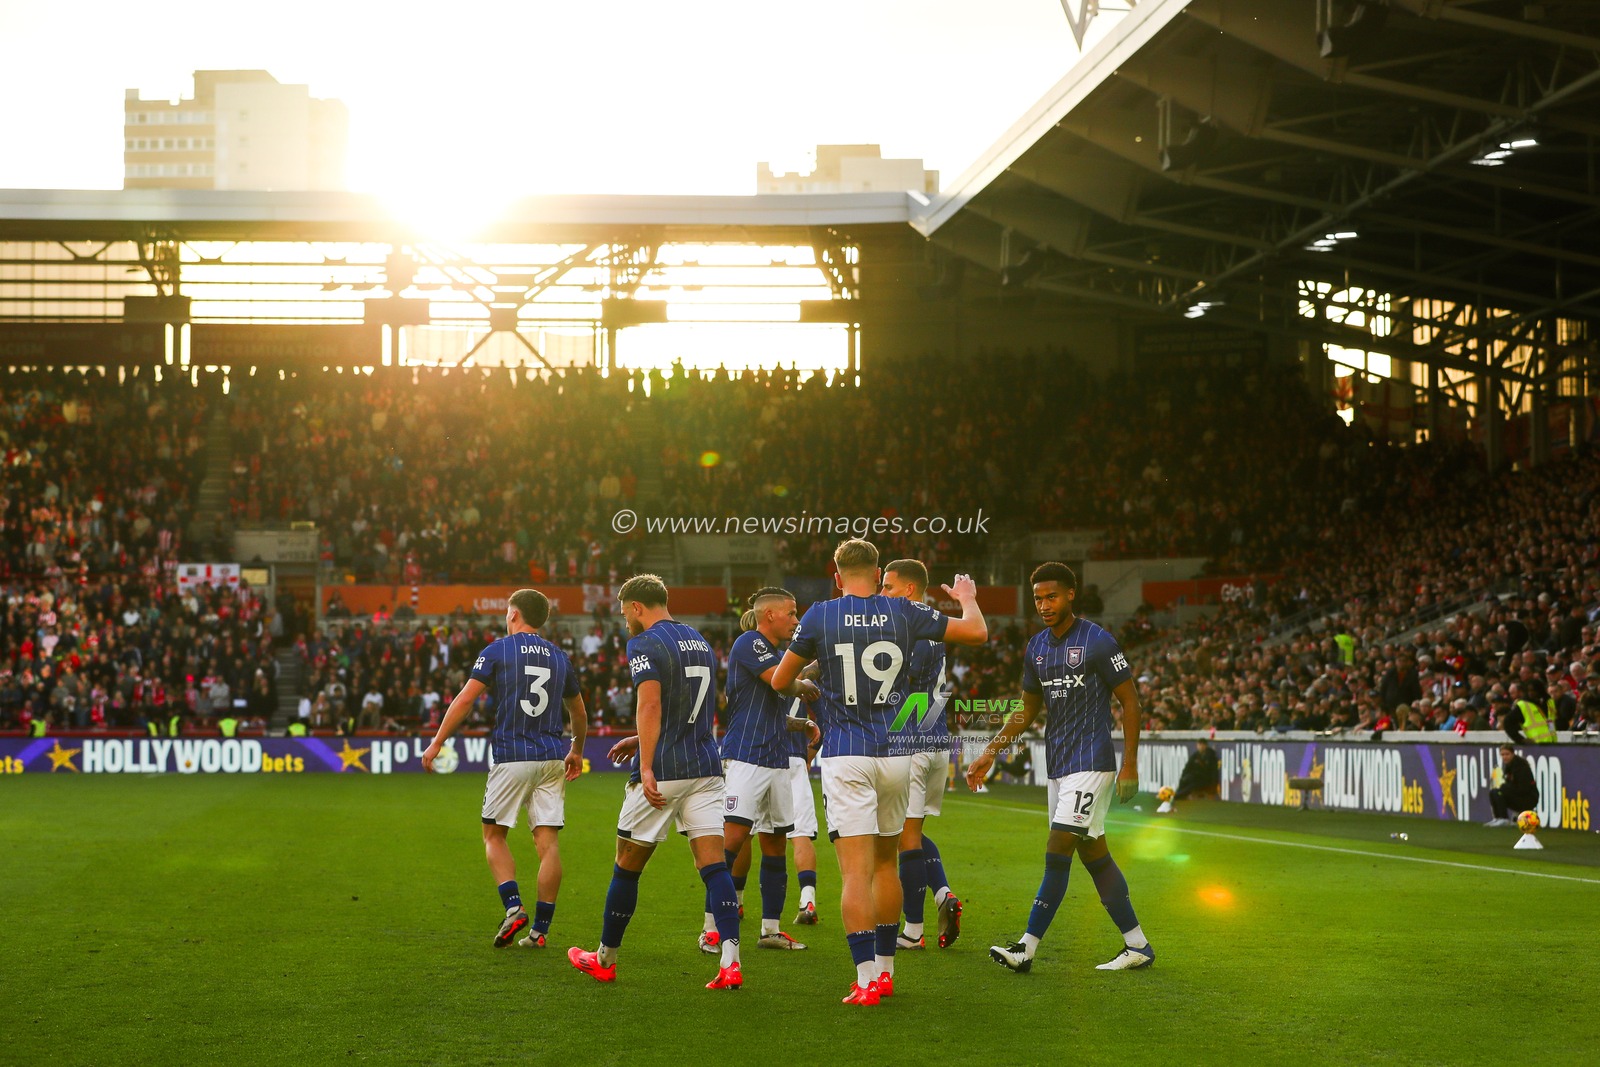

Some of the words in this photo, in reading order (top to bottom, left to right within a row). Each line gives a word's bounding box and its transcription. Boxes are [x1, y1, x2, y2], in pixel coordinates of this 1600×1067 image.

[844, 614, 889, 627] DELAP
[520, 645, 551, 657] DAVIS
[677, 639, 709, 653] BURNS
[519, 665, 551, 718] 3
[834, 640, 904, 706] 19
[684, 665, 711, 724] 7
[82, 739, 262, 773] HOLLYWOOD
[262, 752, 304, 772] bets
[1324, 747, 1402, 813] HOLLYWOOD
[1402, 775, 1424, 814] bets
[1073, 790, 1095, 816] 12
[1562, 786, 1591, 831] bets
